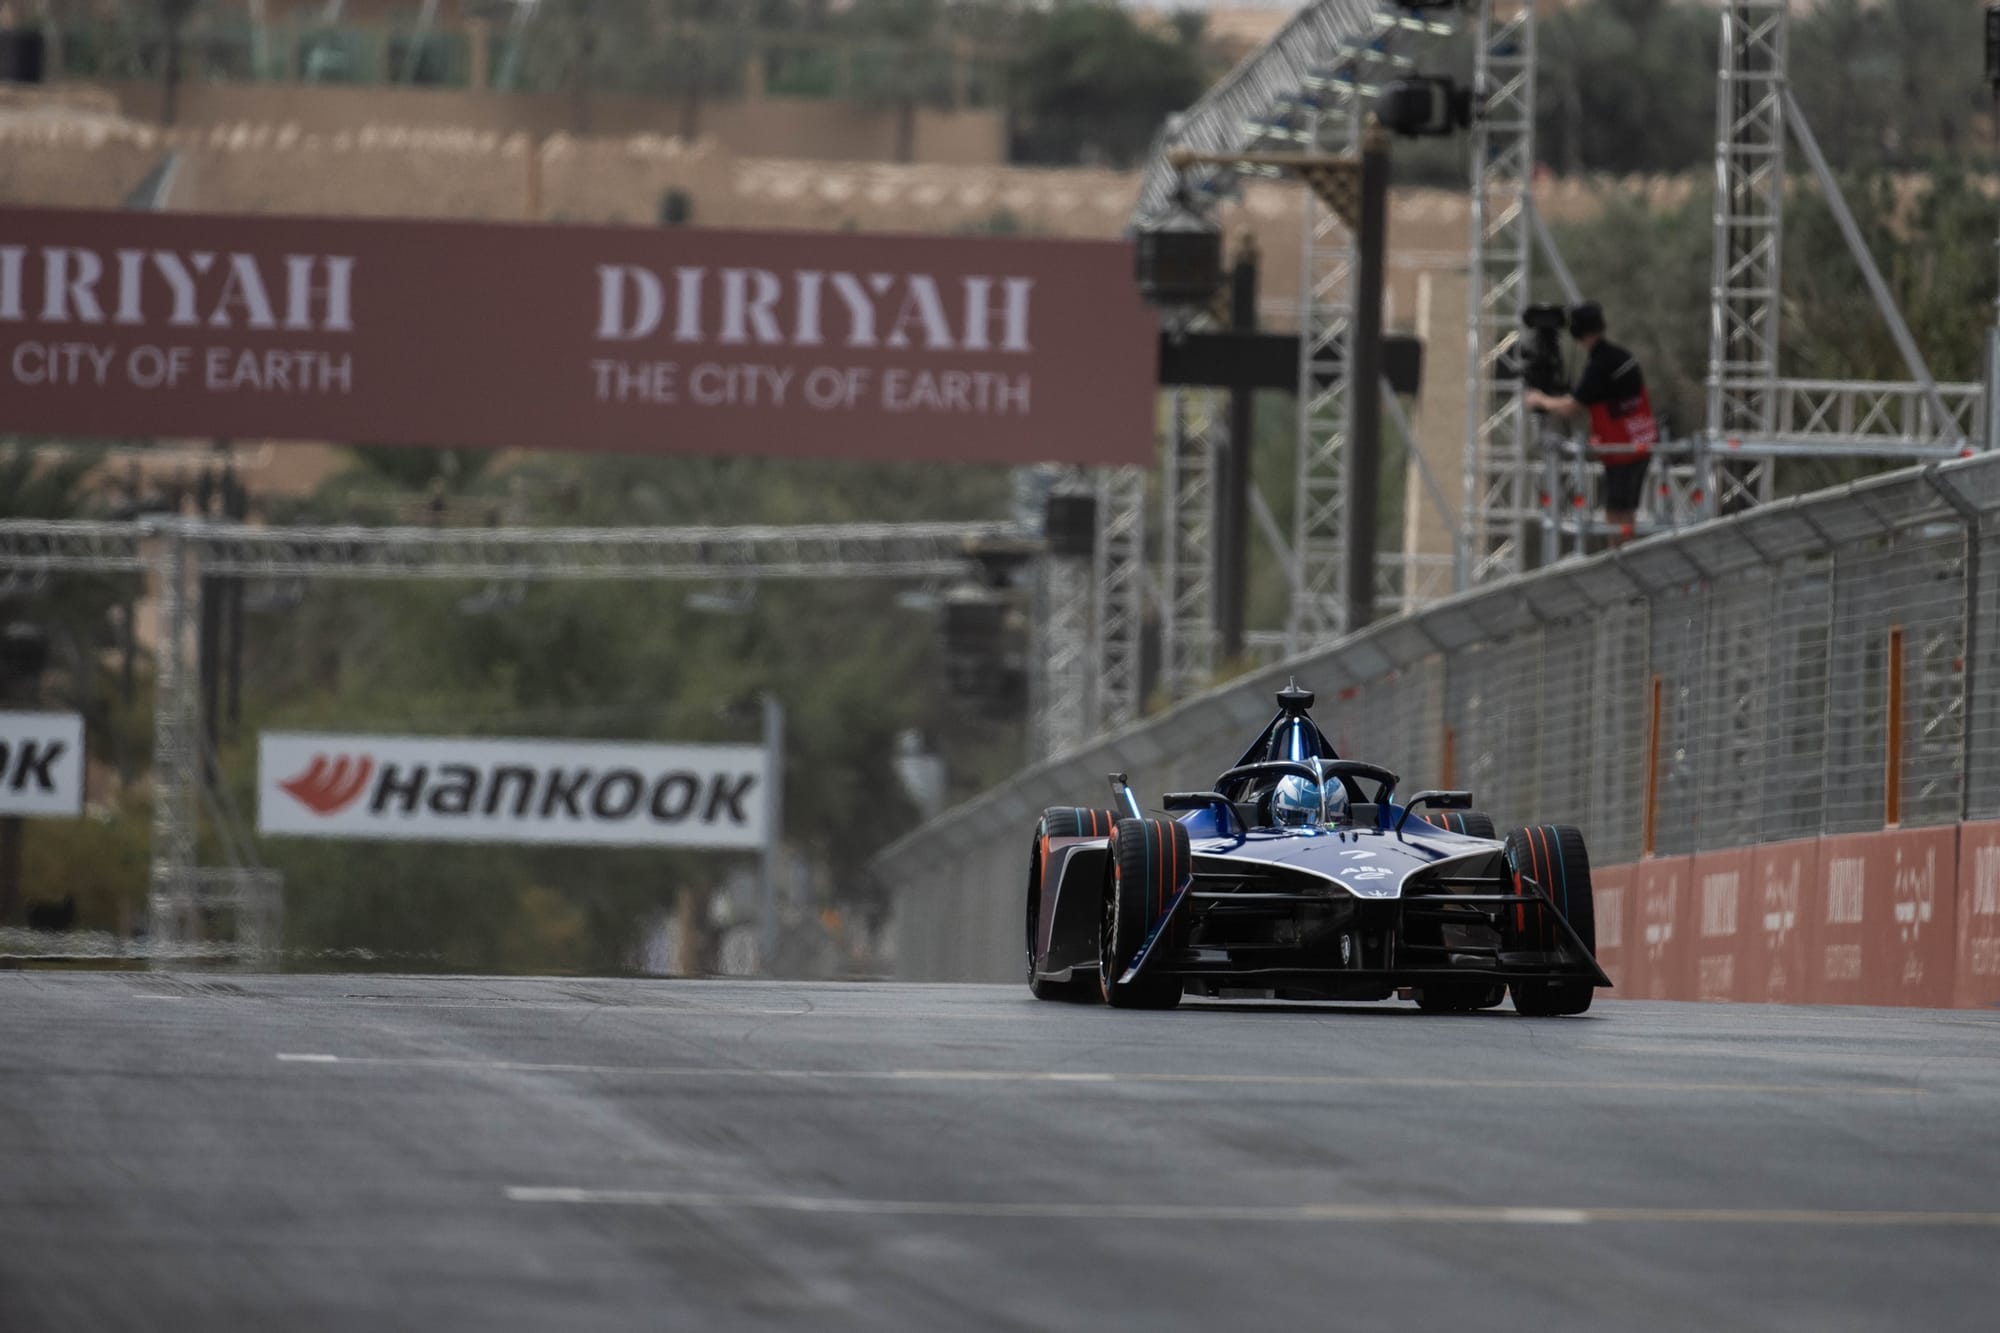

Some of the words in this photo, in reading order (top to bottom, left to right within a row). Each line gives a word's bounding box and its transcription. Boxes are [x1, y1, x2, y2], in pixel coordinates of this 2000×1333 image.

[594, 264, 1036, 352] DIRIYAH
[12, 341, 115, 385] CITY
[127, 345, 193, 388] OF
[206, 348, 352, 392] EARTH
[592, 360, 677, 402] THE
[689, 362, 793, 406] CITY
[804, 366, 870, 410] OF
[881, 369, 1031, 415] EARTH
[0, 739, 65, 793] K
